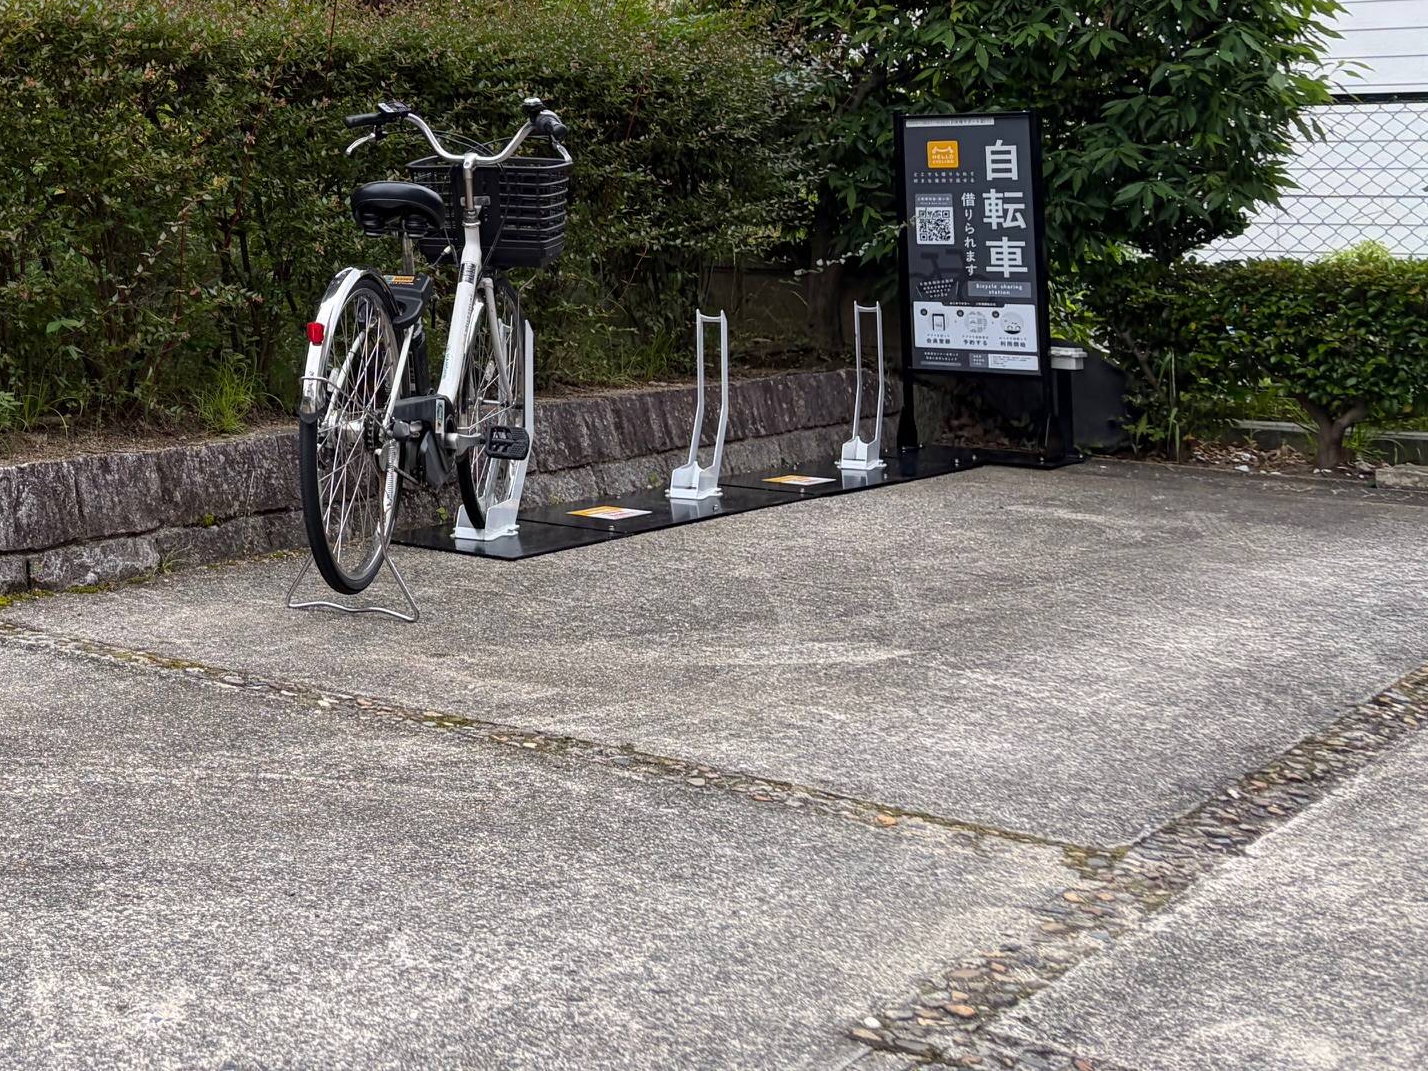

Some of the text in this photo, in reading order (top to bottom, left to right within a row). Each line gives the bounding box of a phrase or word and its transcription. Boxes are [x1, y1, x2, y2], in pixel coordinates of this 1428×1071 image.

[961, 192, 977, 276] 借りられます
[983, 139, 1028, 278] 自転車
[975, 282, 1023, 291] Bicycle sharing
